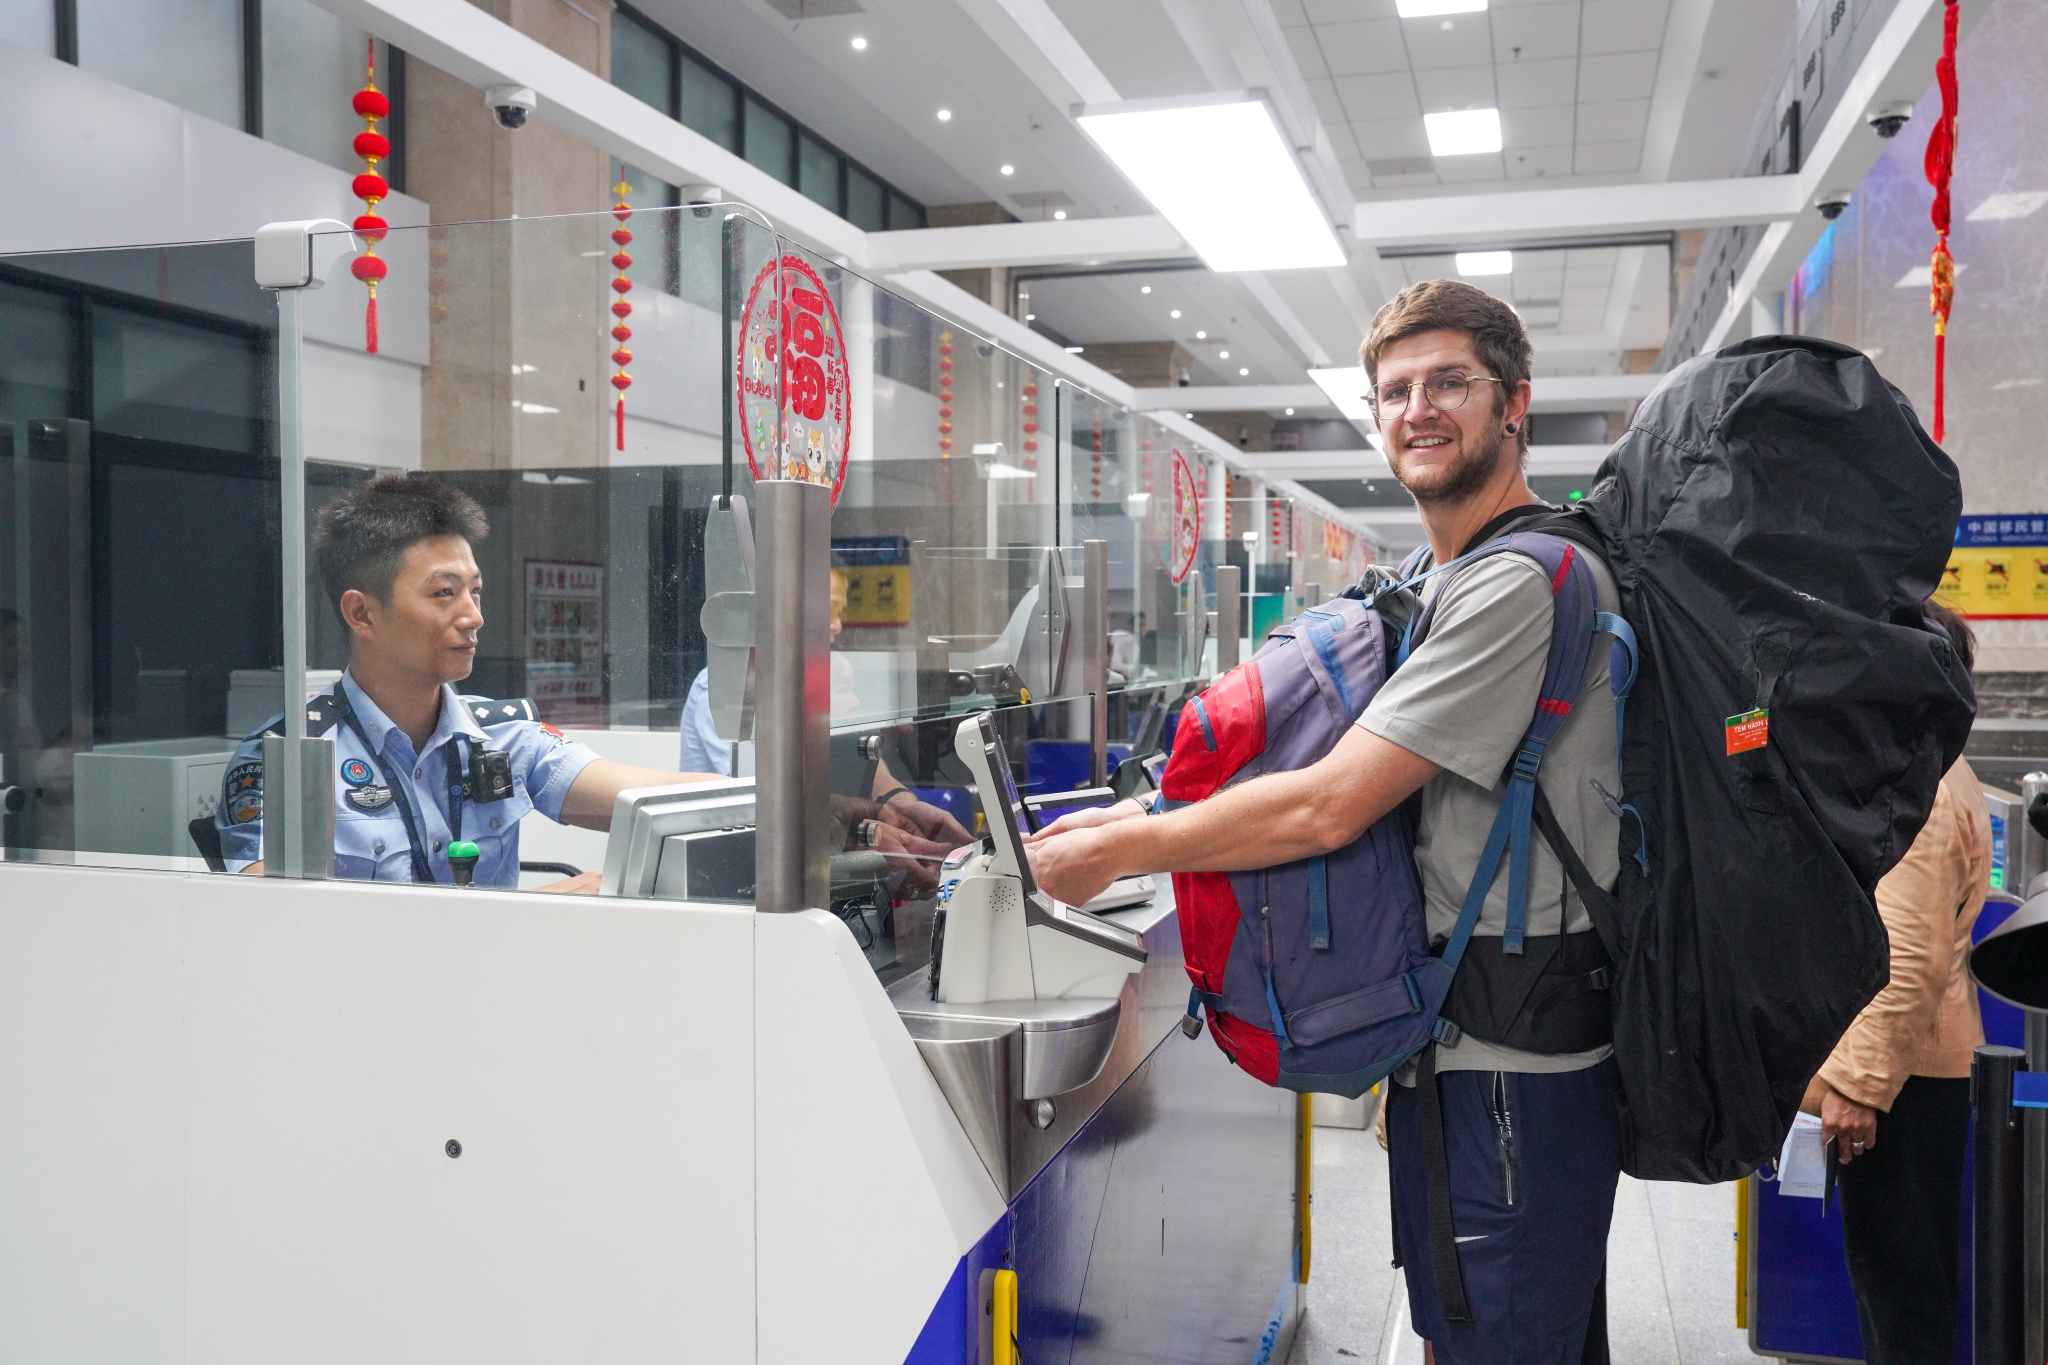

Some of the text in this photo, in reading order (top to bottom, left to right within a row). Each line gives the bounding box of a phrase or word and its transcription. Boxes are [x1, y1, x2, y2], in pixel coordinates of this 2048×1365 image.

[765, 275, 826, 421] 福
[1968, 521, 2048, 534] 中国移民管
[1734, 725, 1746, 733] TEM
[228, 765, 263, 783] 中华人民共
